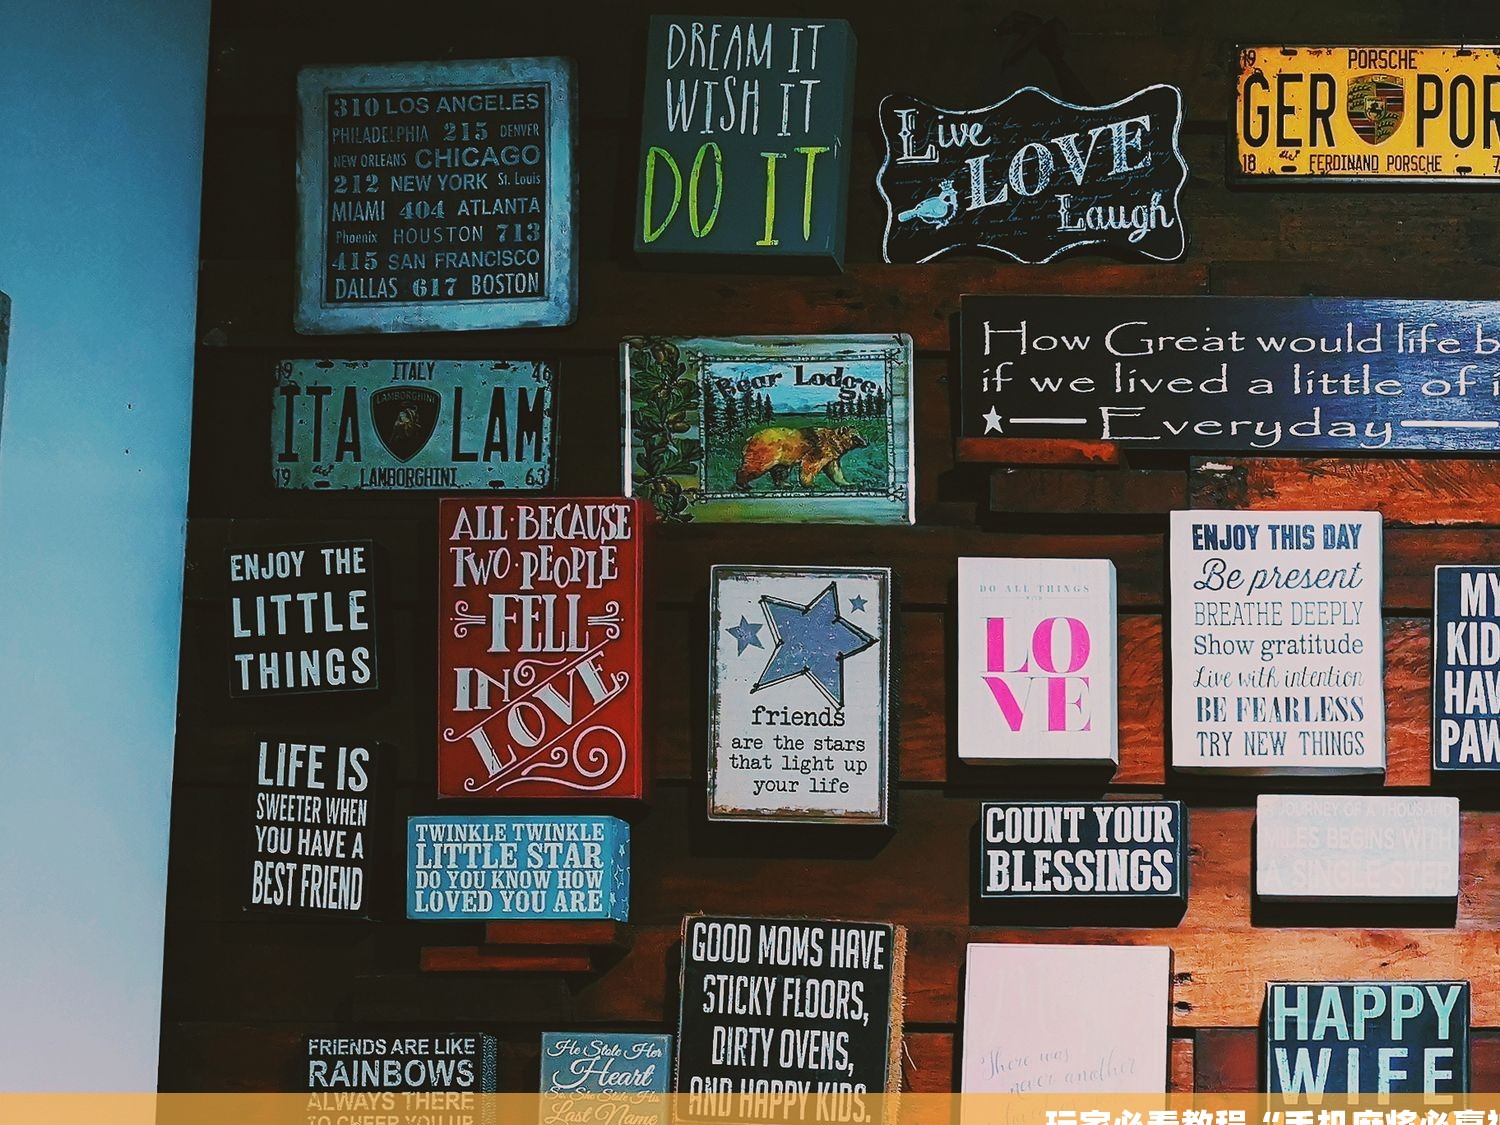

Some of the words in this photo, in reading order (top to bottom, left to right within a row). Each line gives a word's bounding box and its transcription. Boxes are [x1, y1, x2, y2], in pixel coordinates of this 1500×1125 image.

[666, 24, 771, 72] DREAM
[788, 24, 824, 73] IT
[334, 97, 379, 118] 310
[386, 96, 429, 115] LOS
[436, 95, 539, 113] ANGELES
[1242, 73, 1336, 148] GER
[894, 109, 991, 164] Live
[966, 114, 1154, 210] LOVE
[1309, 155, 1378, 172] FERDINAND
[1385, 154, 1442, 172] PORSCHE
[333, 202, 386, 221] MIAMI
[399, 200, 445, 220] 404
[458, 198, 540, 215] ATLANTA
[1055, 193, 1174, 242] Laugh
[335, 277, 397, 299] DALLAS
[412, 277, 458, 297] 617
[472, 273, 539, 295] BOSTON
[982, 321, 1090, 355] How
[1105, 321, 1245, 356] Great
[1257, 324, 1382, 354] would
[1397, 323, 1460, 354] life
[716, 369, 782, 397] Bear
[793, 365, 877, 403] Lodge
[278, 387, 361, 463] ITA
[452, 386, 545, 462] LAM
[1099, 406, 1394, 447] Everyday
[361, 468, 457, 488] LAMBORGHINI
[450, 506, 508, 542] ALL
[518, 504, 630, 546] BECAUSE
[1192, 525, 1259, 550] ENJOY
[1268, 524, 1315, 549] THIS
[1323, 524, 1362, 550] DAY
[230, 555, 303, 582] ENJOY
[322, 547, 366, 574] THE
[232, 590, 367, 639] LITTLE
[487, 594, 589, 653] FELL
[1194, 634, 1254, 656] Show
[1261, 634, 1364, 661] gratitude
[235, 646, 370, 691] THINGS
[751, 706, 845, 729] friends
[258, 743, 325, 788] LIFE
[338, 747, 368, 792] IS
[986, 808, 1086, 843] COUNT
[1096, 806, 1174, 843] YOUR
[417, 844, 519, 868] LITTLE
[528, 844, 603, 868] STAR
[986, 849, 1172, 894] BLESSINGS
[252, 862, 296, 905] BEST
[301, 863, 362, 912] FRIEND
[692, 923, 750, 962] GOOD
[758, 925, 823, 967] MOMS
[830, 930, 884, 970] HAVE
[1274, 985, 1461, 1041] HAPPY
[308, 1039, 386, 1055] FRIENDS
[394, 1039, 429, 1054] ARE
[435, 1039, 475, 1054] LIKE
[308, 1060, 474, 1087] RAINBOWS
[554, 1058, 654, 1089] Heart
[1274, 1047, 1453, 1106] WIFE
